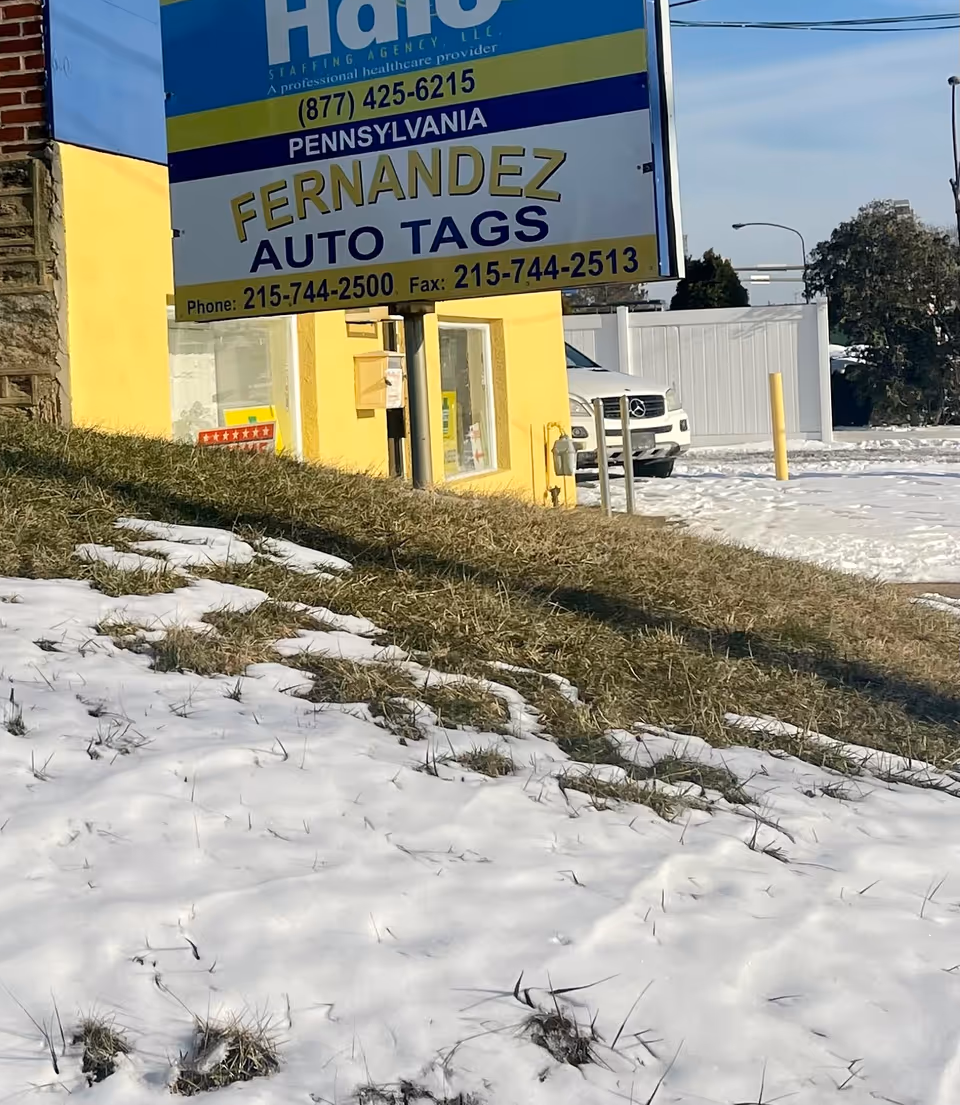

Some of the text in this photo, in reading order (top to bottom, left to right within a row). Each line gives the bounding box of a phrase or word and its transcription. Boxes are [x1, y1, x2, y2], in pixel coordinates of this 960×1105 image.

[267, 43, 498, 96] A professional healthcare provider
[268, 54, 354, 80] STAFFING
[297, 68, 476, 129] (877) 425-6215
[288, 107, 488, 159] PENNSYLVANIA
[230, 145, 567, 243] FERNANDEZ
[249, 206, 550, 274] AUTO TAGS
[186, 246, 640, 317] Phone: 215-744-2500 Fax: 215-744-2513
